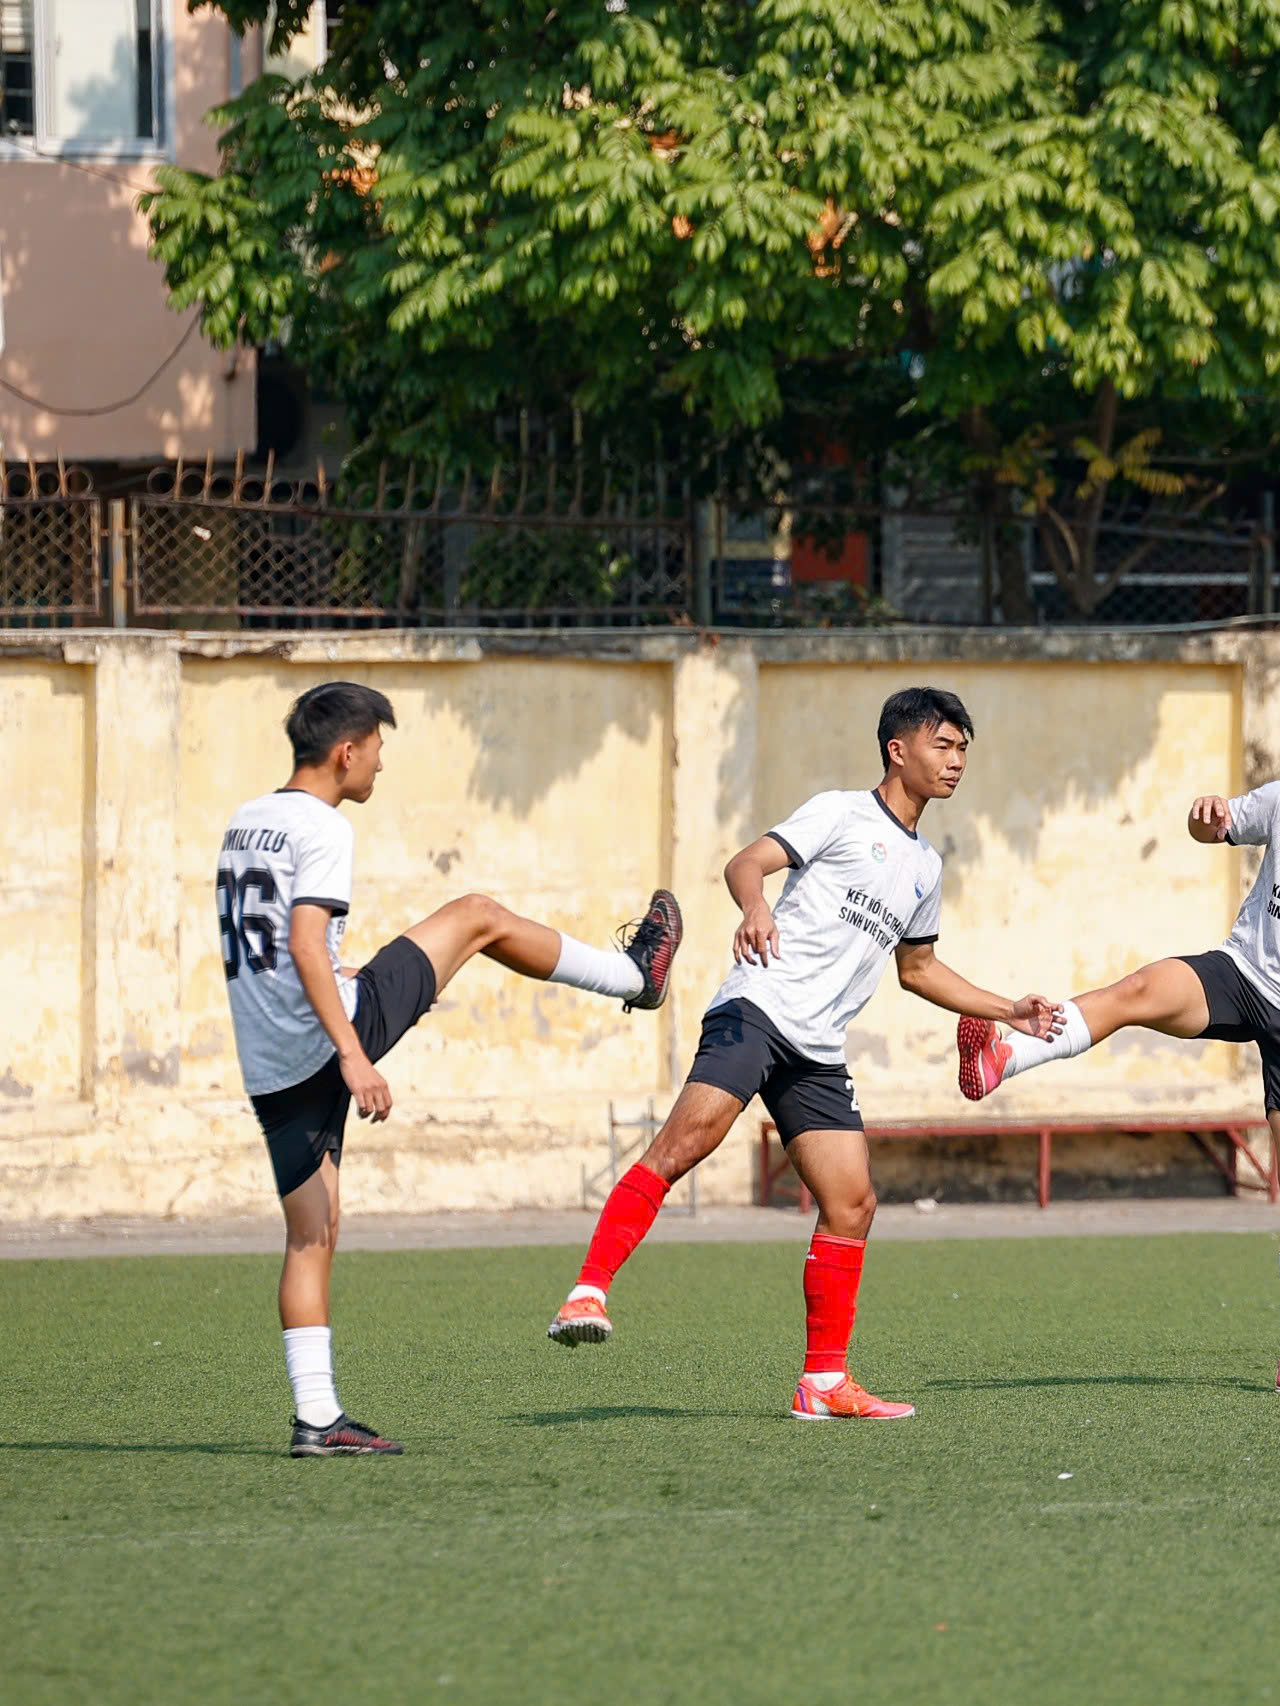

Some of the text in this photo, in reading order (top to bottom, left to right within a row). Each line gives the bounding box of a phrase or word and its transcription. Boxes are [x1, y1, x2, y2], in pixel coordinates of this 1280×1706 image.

[255, 828, 288, 853] TLU
[846, 887, 869, 907] KẾT
[838, 906, 865, 929] SINH
